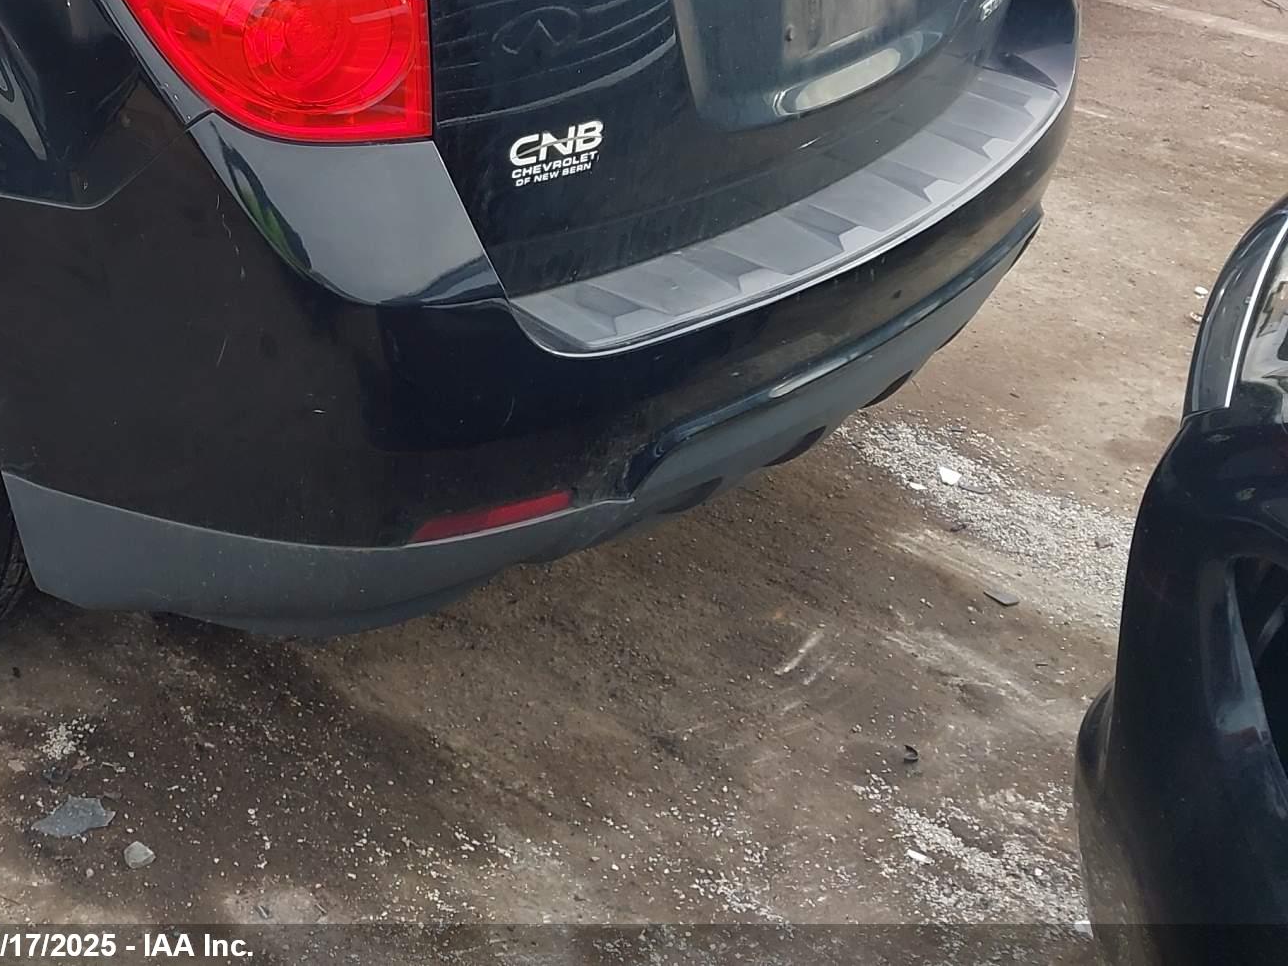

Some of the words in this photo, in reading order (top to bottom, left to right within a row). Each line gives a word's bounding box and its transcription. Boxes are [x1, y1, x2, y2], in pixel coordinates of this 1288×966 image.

[510, 120, 604, 166] CNB
[512, 151, 598, 179] CHEVROLET
[515, 177, 532, 187] OF
[534, 170, 560, 183] NEW
[562, 162, 592, 176] BERN
